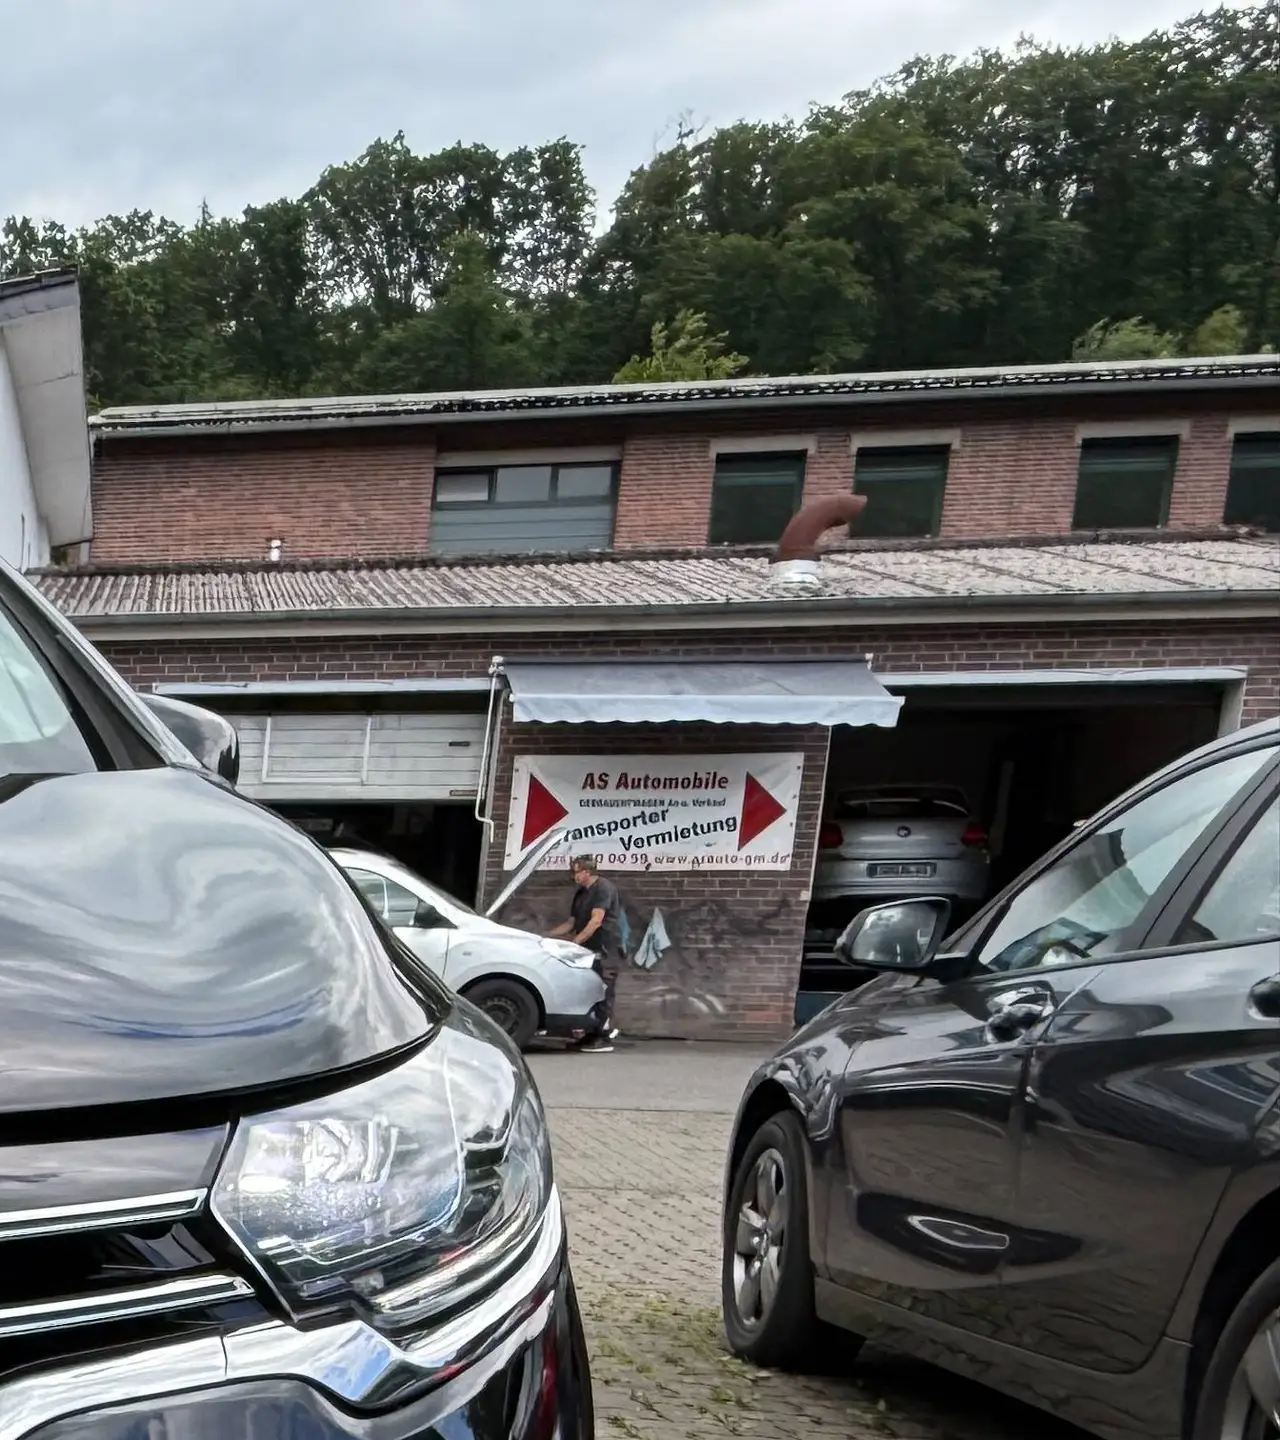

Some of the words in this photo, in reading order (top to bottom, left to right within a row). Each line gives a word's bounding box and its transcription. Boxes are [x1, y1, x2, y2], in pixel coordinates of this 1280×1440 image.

[582, 772, 610, 790] AS
[615, 771, 729, 791] Automobile
[563, 808, 669, 843] ransporter
[619, 816, 738, 852] Vermietung
